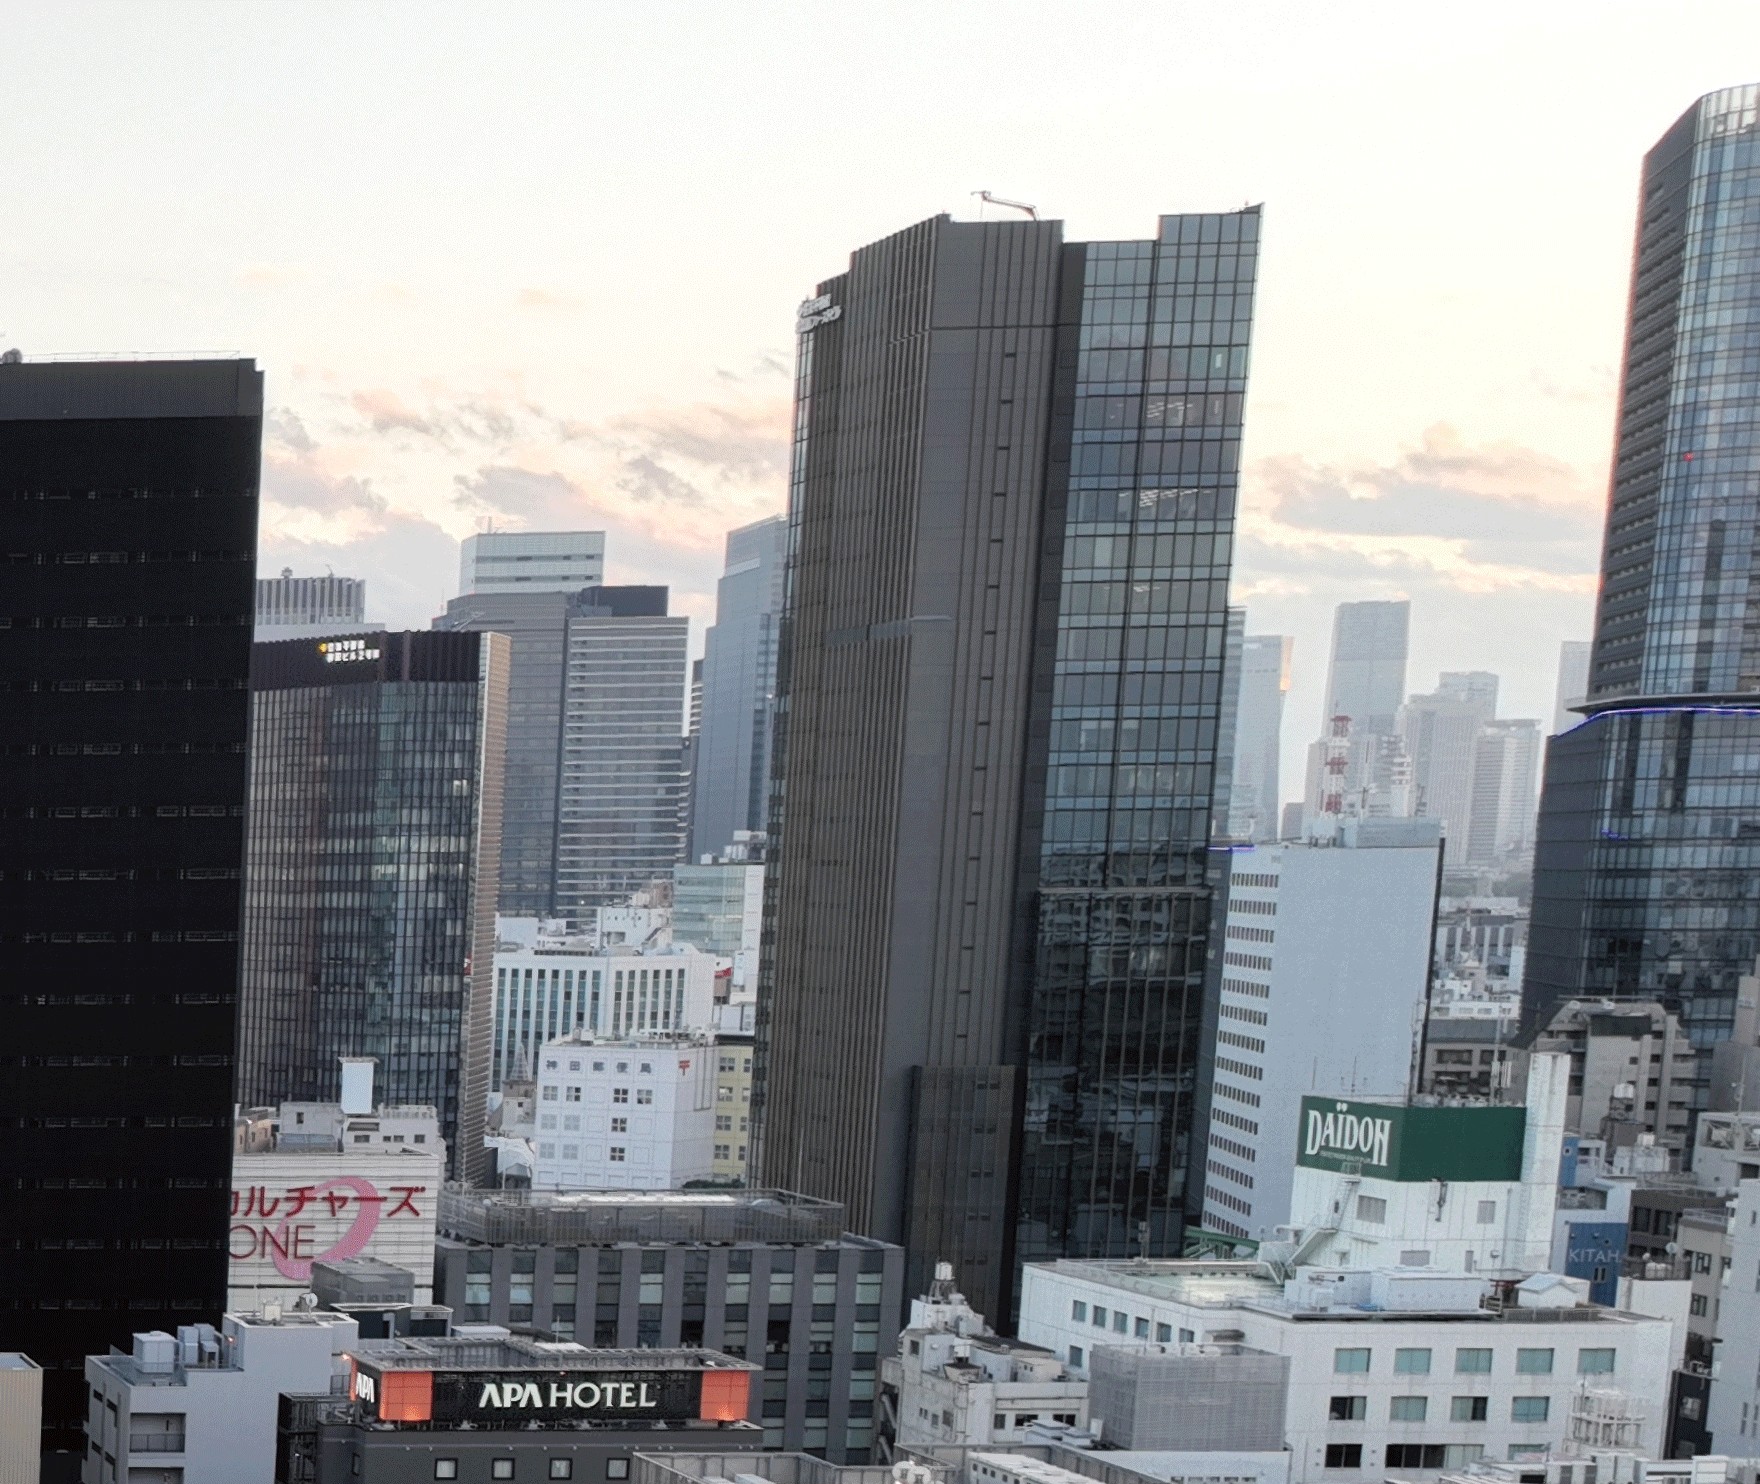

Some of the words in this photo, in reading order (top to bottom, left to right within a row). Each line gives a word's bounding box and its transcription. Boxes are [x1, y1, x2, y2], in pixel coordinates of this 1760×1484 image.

[230, 1225, 316, 1259] ONE
[356, 1371, 375, 1402] APA
[480, 1382, 544, 1408] APA
[549, 1382, 658, 1408] HOTEL
